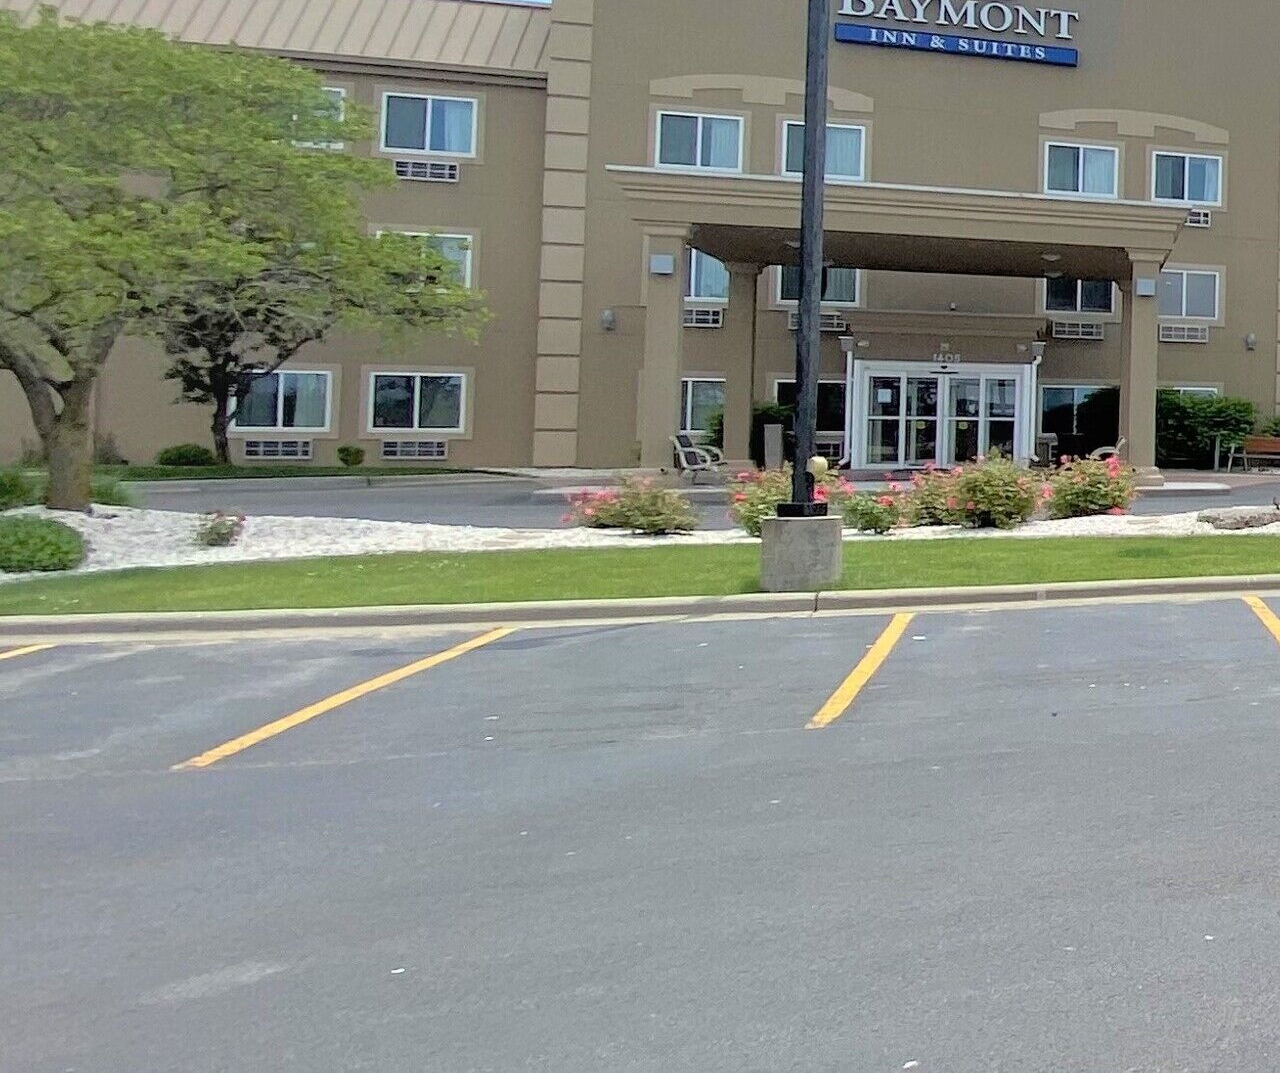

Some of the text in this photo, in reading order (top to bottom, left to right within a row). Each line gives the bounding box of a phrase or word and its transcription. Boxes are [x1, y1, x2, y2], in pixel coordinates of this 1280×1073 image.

[869, 28, 1047, 59] INN & SUITES
